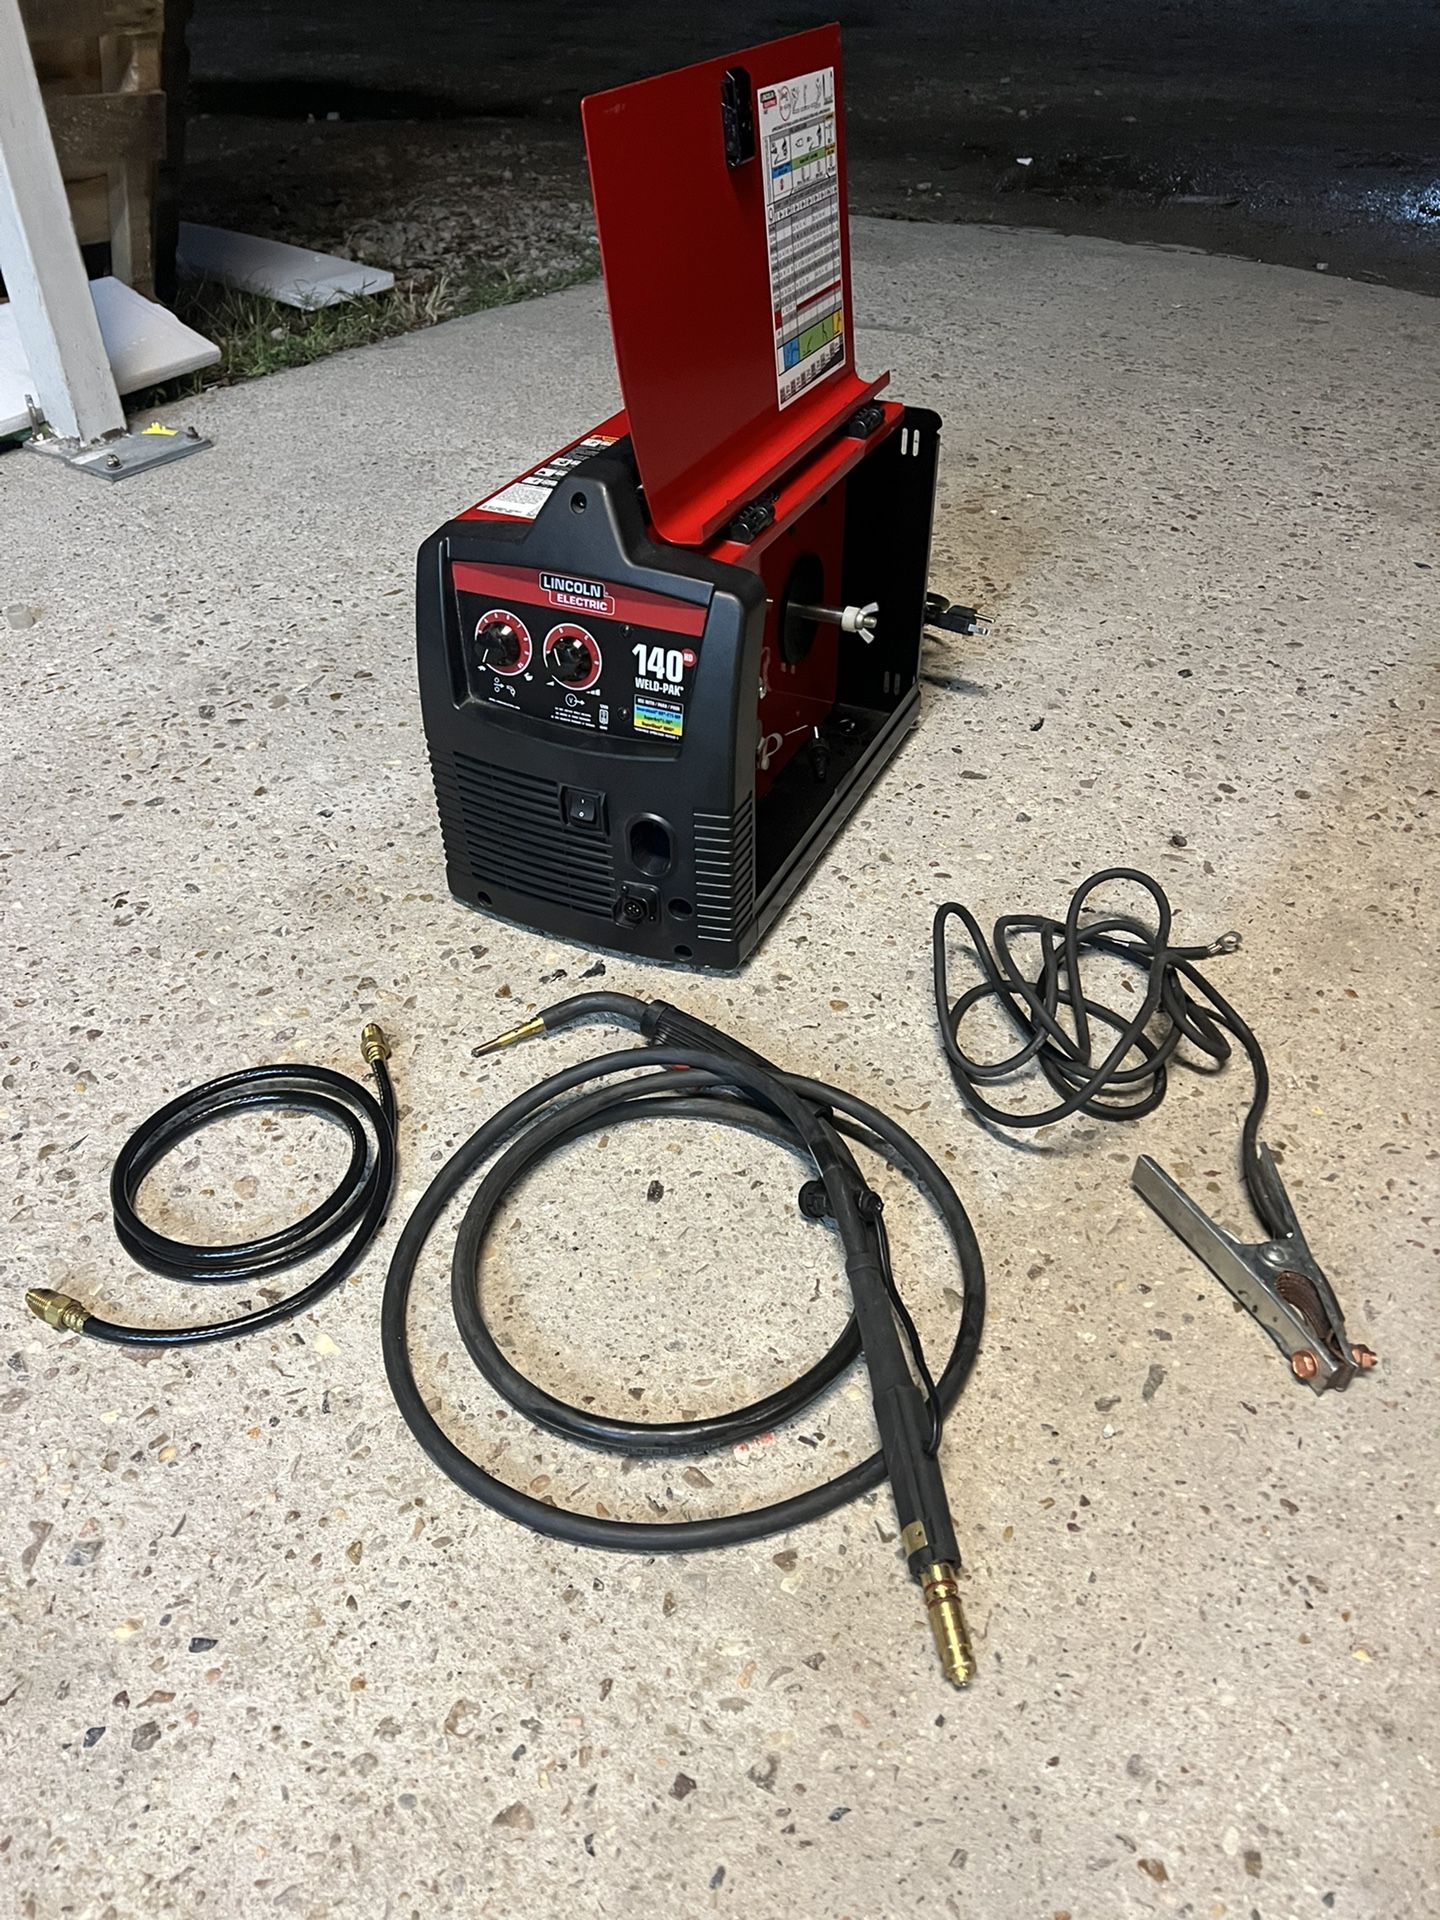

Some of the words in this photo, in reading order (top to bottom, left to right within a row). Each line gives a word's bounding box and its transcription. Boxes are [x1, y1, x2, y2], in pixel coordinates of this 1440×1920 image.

[543, 576, 601, 597] LINCOLN
[557, 594, 608, 611] ELECTRIC
[632, 643, 684, 683] 140
